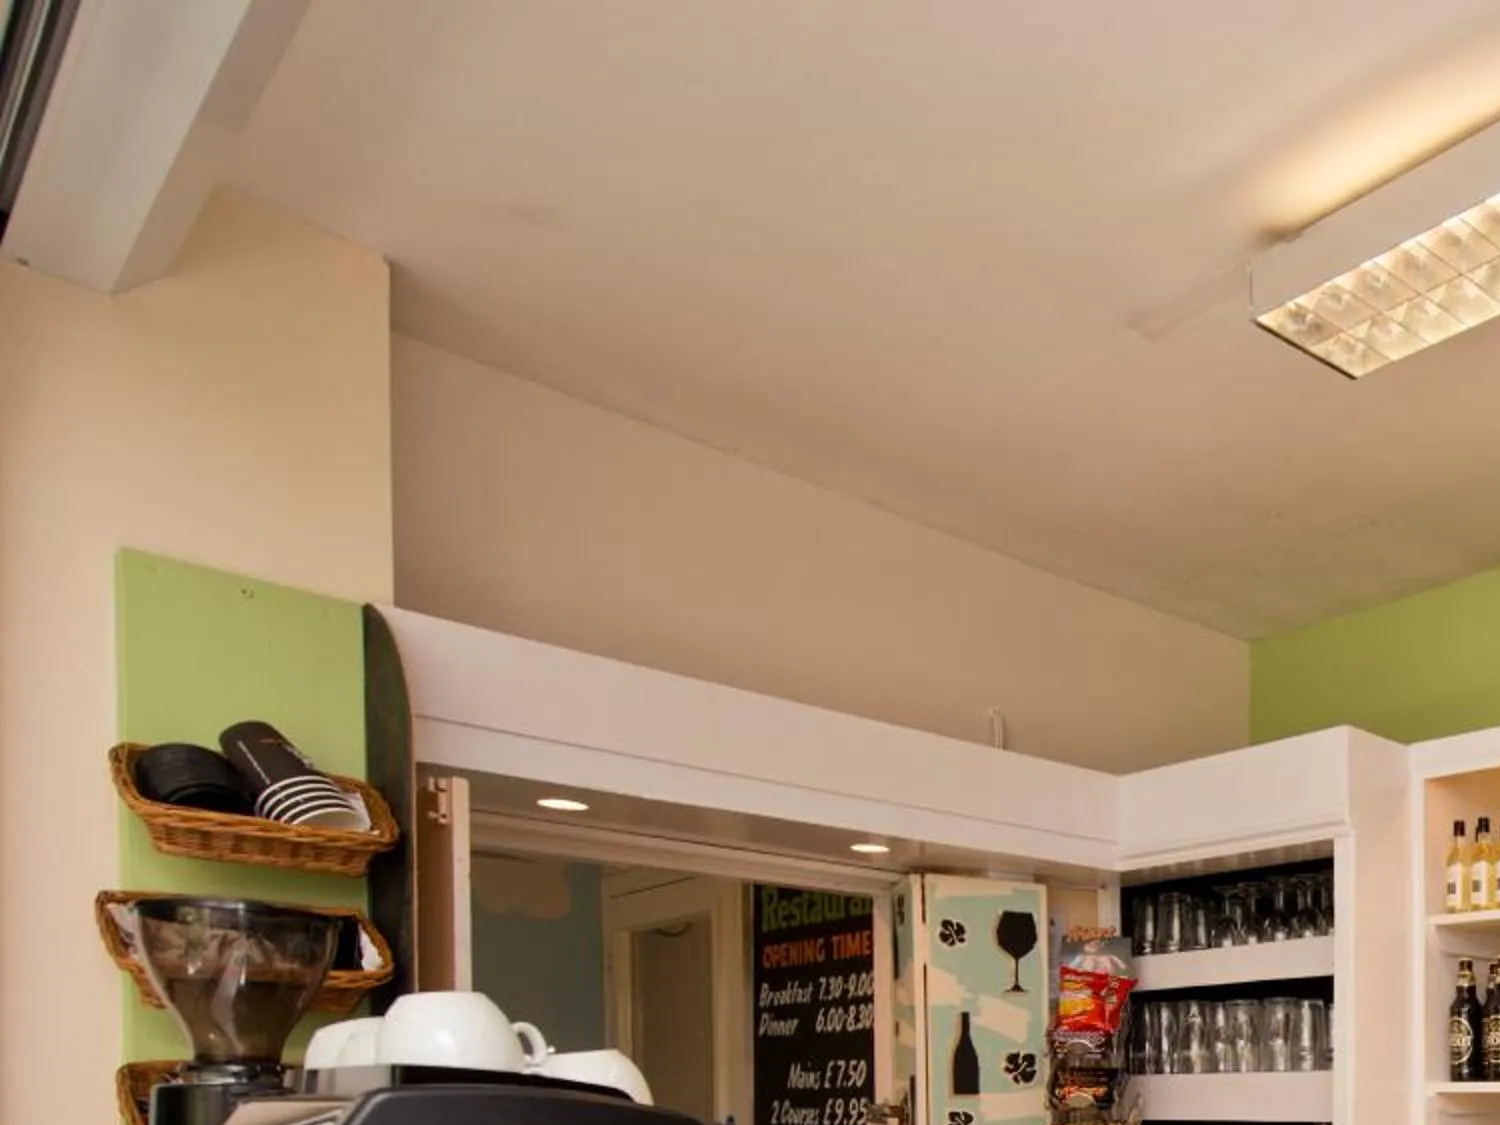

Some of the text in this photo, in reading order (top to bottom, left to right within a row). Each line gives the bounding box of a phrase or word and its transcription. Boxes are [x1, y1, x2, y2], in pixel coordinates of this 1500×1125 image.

[763, 938, 826, 969] OPENING
[759, 981, 814, 1007] Breakfast
[759, 1012, 799, 1038] Dinner
[787, 1061, 821, 1090] Mains
[770, 1100, 780, 1125] 2
[781, 1098, 820, 1125] Courses
